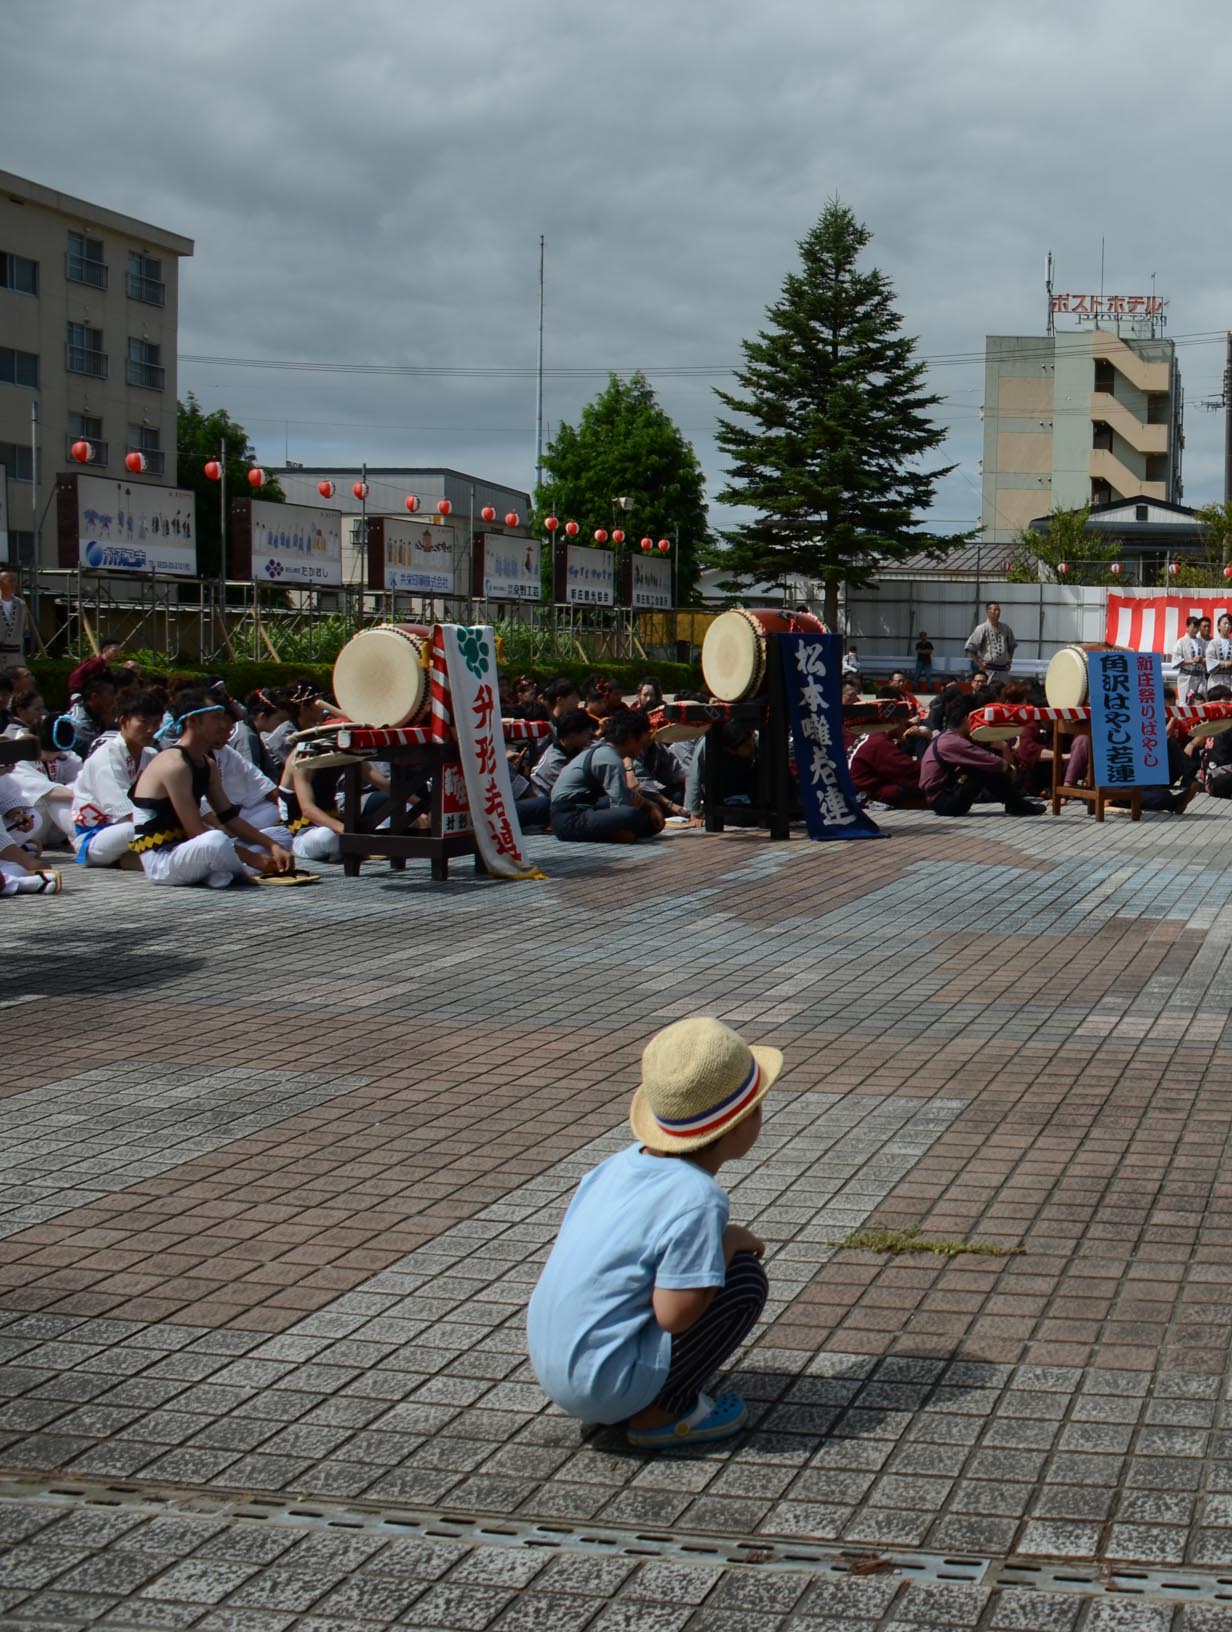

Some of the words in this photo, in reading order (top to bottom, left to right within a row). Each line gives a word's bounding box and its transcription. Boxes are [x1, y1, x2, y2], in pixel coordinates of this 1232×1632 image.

[1136, 656, 1159, 768] 新庄祭りばやし
